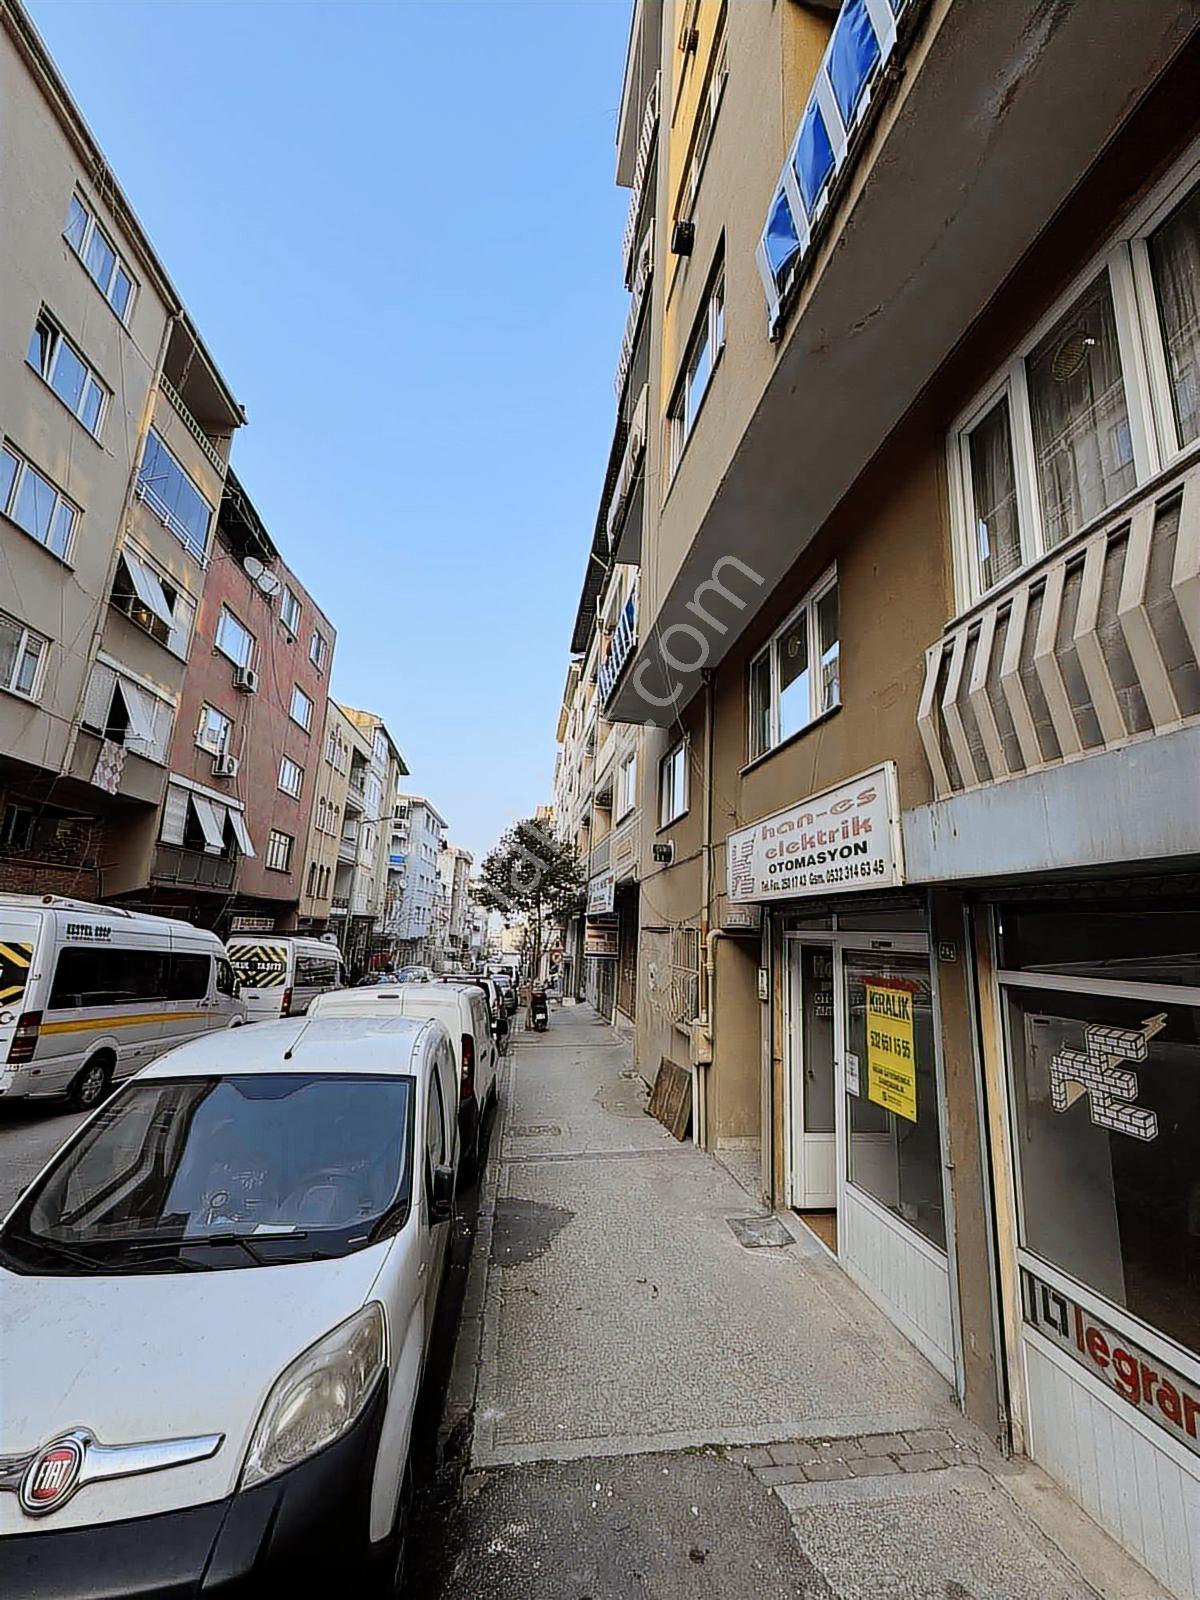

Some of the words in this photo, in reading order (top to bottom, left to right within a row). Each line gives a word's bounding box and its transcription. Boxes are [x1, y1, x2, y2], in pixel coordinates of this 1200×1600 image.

[765, 815, 873, 860] elektrik
[768, 840, 868, 874] OTOMASYON
[845, 865, 859, 880] 314
[873, 859, 885, 875] 45
[34, 1459, 71, 1490] FIAT
